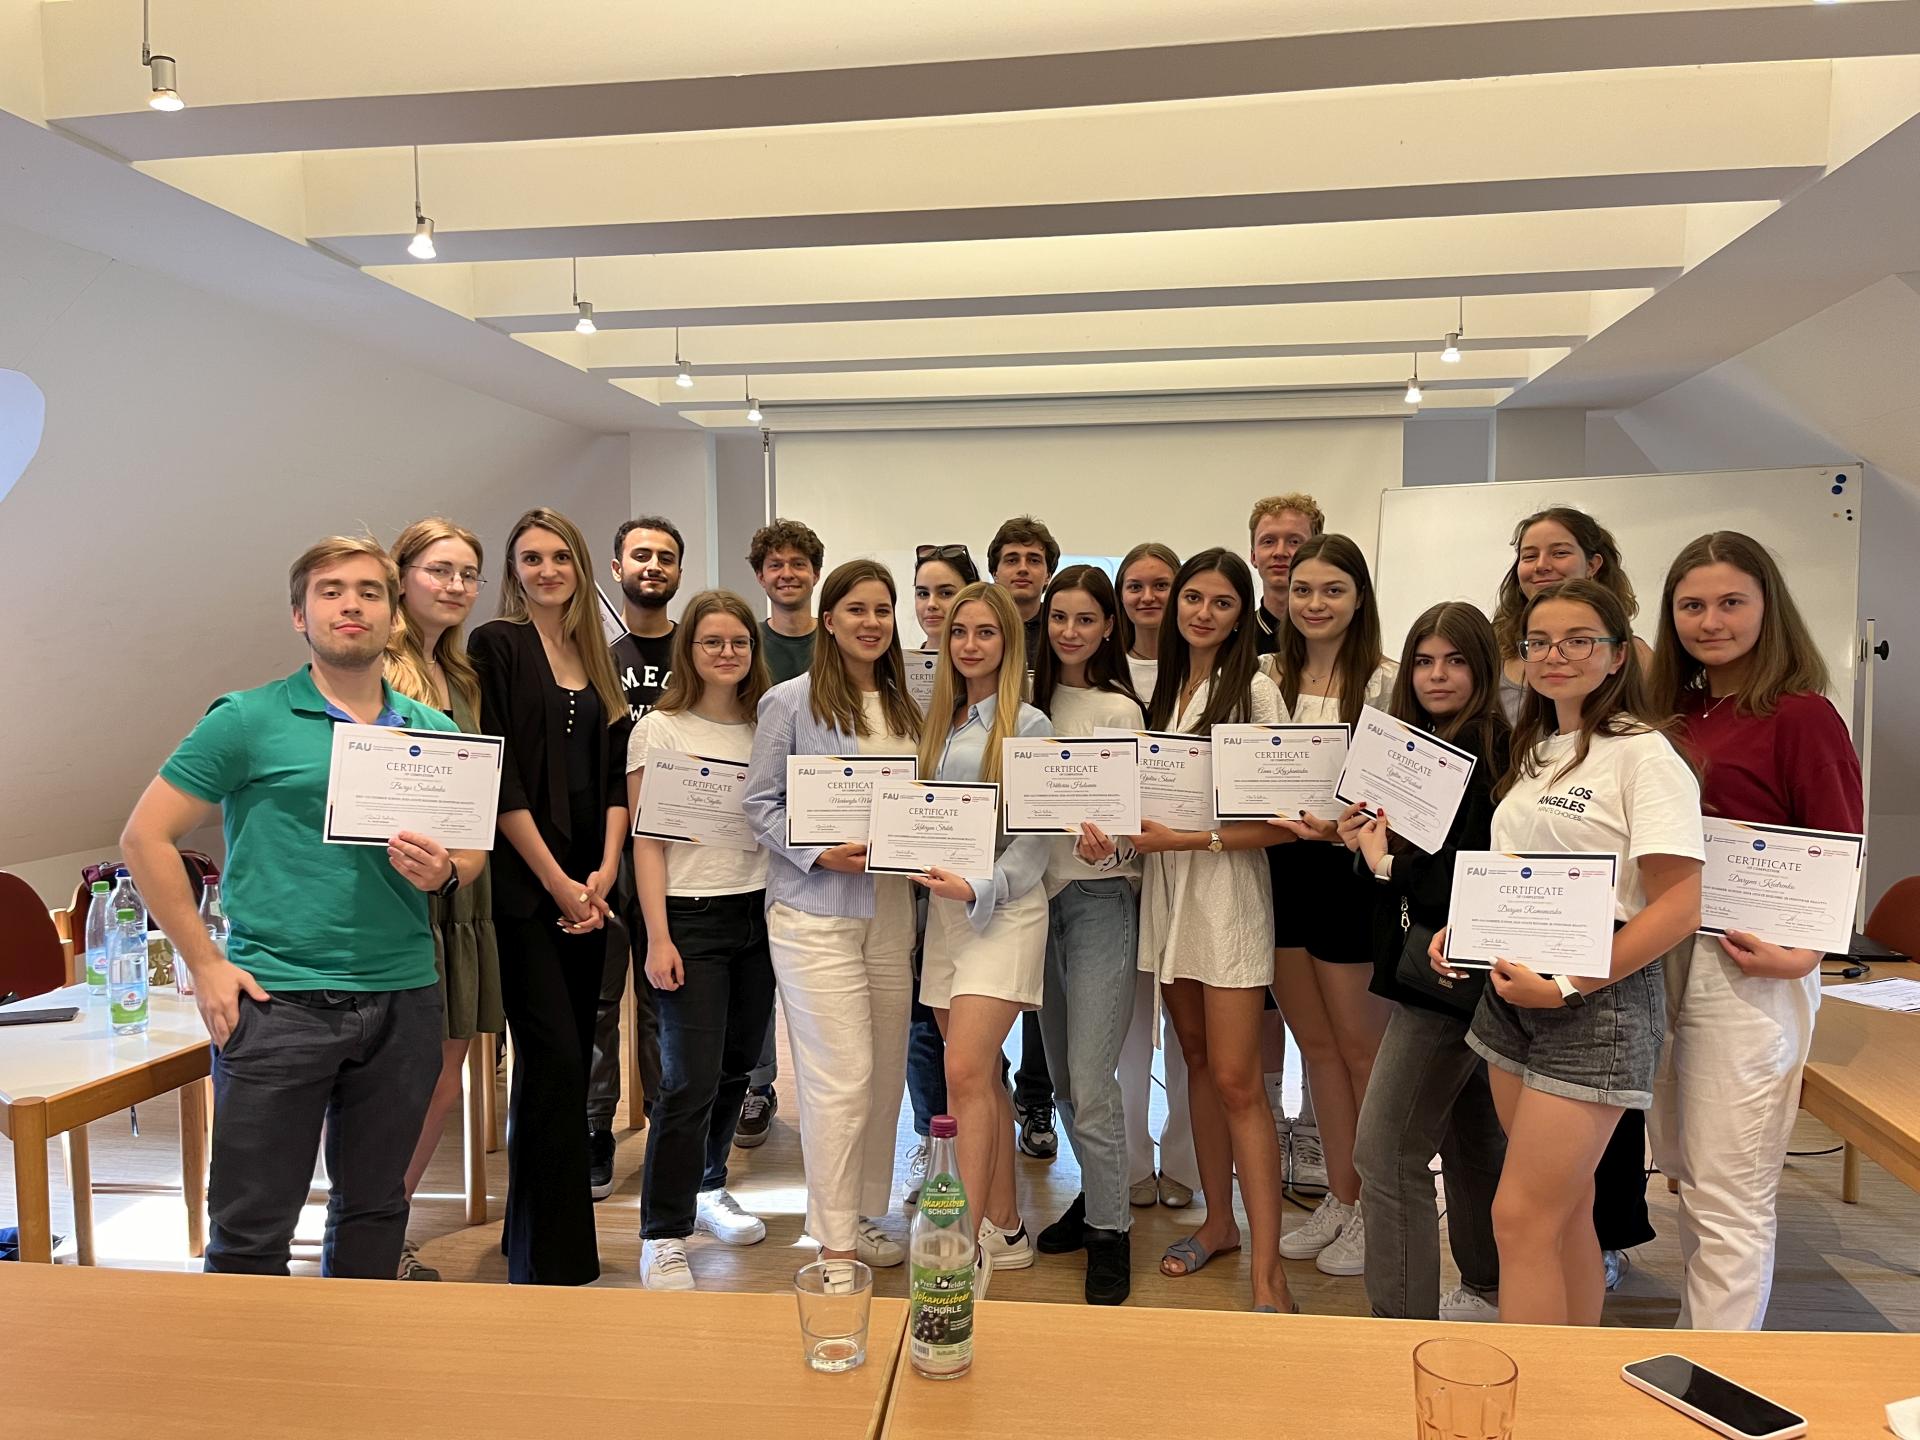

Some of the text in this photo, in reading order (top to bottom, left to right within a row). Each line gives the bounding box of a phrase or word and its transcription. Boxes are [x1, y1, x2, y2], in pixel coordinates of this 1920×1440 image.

[1367, 723, 1384, 736] FAU
[348, 741, 372, 752] FAU
[1223, 737, 1242, 746] FAU
[1014, 751, 1032, 760] FAU
[1254, 751, 1310, 759] CERTIFICATE
[656, 761, 674, 771] FAU
[1387, 749, 1433, 777] CERTIFICATE
[386, 762, 453, 775] CERTIFICATE
[798, 768, 816, 776] FAU
[1044, 765, 1099, 774] CERTIFICATE
[682, 779, 733, 793] CERTIFICATE
[827, 781, 873, 789] CERTIFICAT
[882, 792, 900, 801] FAU
[1567, 786, 1594, 800] LOS
[1536, 795, 1587, 814] ANGELES
[908, 807, 959, 817] CERTIFICATE
[1727, 854, 1802, 871] CERTIFICATE
[1466, 867, 1488, 877] FAU
[1499, 885, 1564, 896] CERTIFICATE
[922, 1304, 963, 1315] SCHORLE
